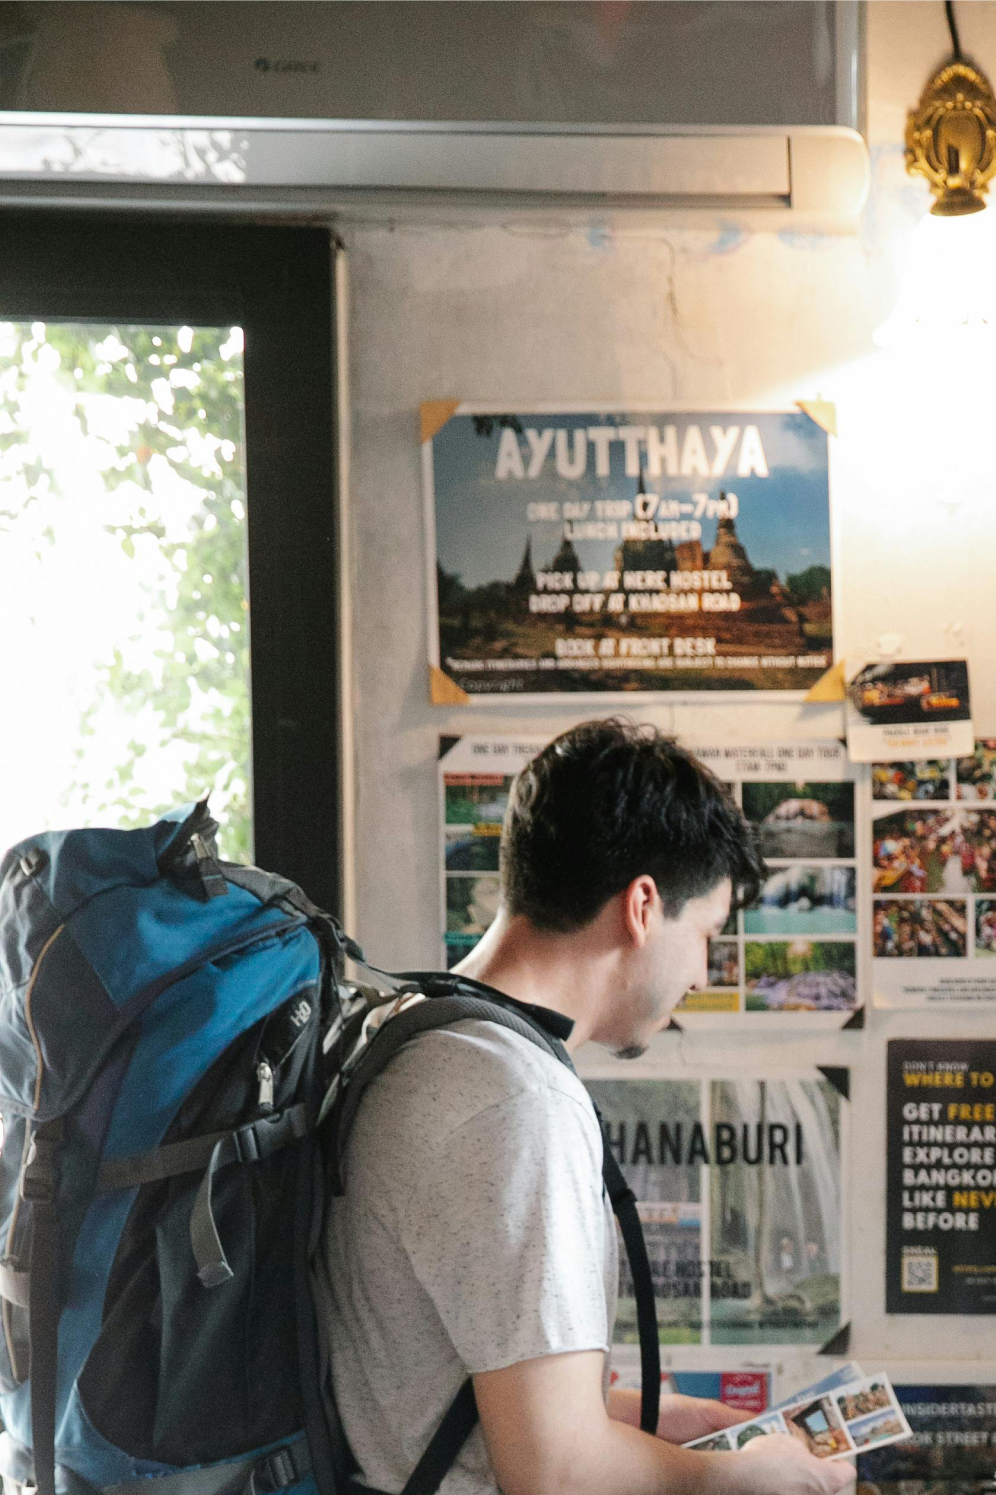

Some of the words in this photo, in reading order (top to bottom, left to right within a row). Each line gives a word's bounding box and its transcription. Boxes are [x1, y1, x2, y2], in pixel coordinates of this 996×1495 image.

[495, 424, 770, 480] AYUTTHAYA
[620, 520, 702, 541] INCLUDED
[535, 570, 574, 591] PICK
[576, 570, 600, 591] UP
[602, 569, 620, 590] AT
[623, 569, 667, 590] HERE
[528, 593, 570, 614] DROP
[572, 593, 606, 614] OFF
[607, 592, 626, 613] AT
[701, 592, 741, 613] ROAD
[555, 637, 595, 657] BOOK
[598, 637, 616, 656] AT
[619, 637, 669, 657] FRONT
[673, 636, 717, 656] DESK
[903, 1071, 965, 1088] WHERE
[970, 1071, 995, 1087] TO
[902, 1102, 942, 1122] GET
[947, 1103, 996, 1122] FREE
[605, 1120, 803, 1166] HANABURI
[902, 1146, 996, 1165] EXPLORE
[902, 1190, 947, 1209] LIKE
[902, 1211, 980, 1231] BEFORE
[936, 1431, 988, 1447] STREET
